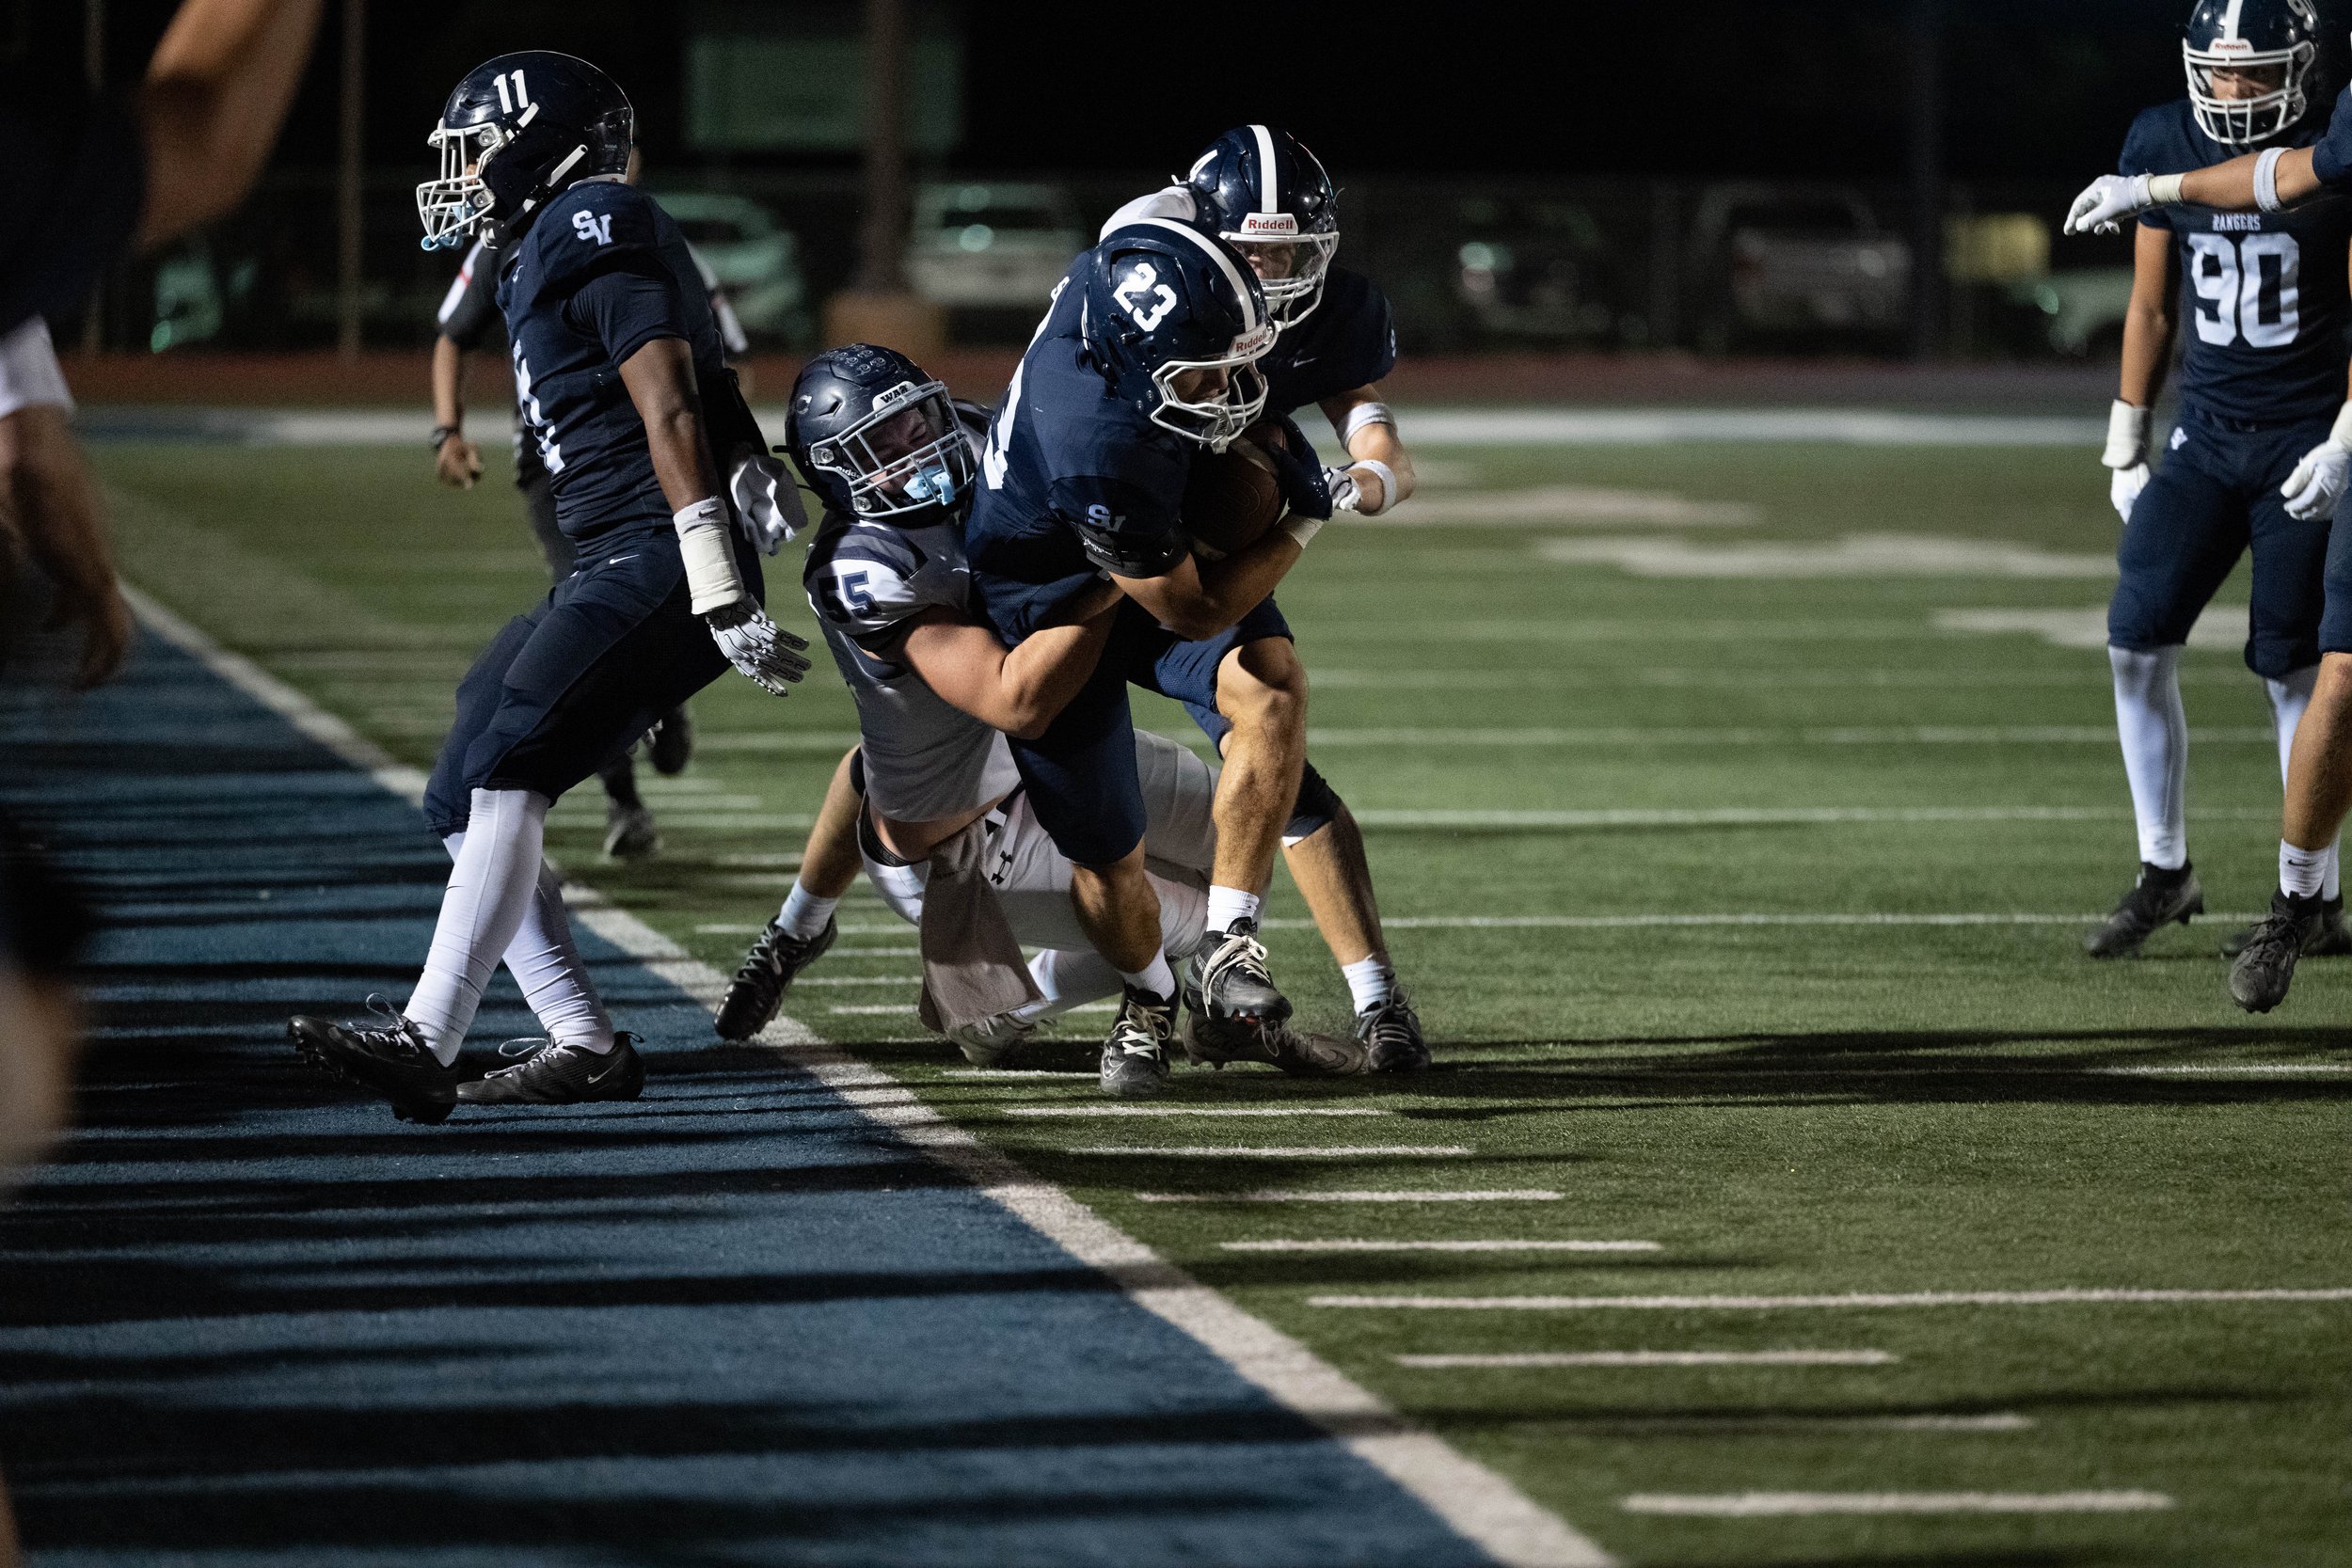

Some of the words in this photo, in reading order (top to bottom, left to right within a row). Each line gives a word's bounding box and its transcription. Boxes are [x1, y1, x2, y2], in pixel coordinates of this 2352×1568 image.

[493, 69, 529, 115] 11
[572, 210, 612, 246] SV
[1248, 219, 1294, 230] Riddell
[2213, 213, 2261, 231] RANGERS
[1113, 262, 1177, 332] 23
[2188, 232, 2300, 348] 90
[1087, 503, 1127, 532] SV
[818, 570, 882, 625] 55
